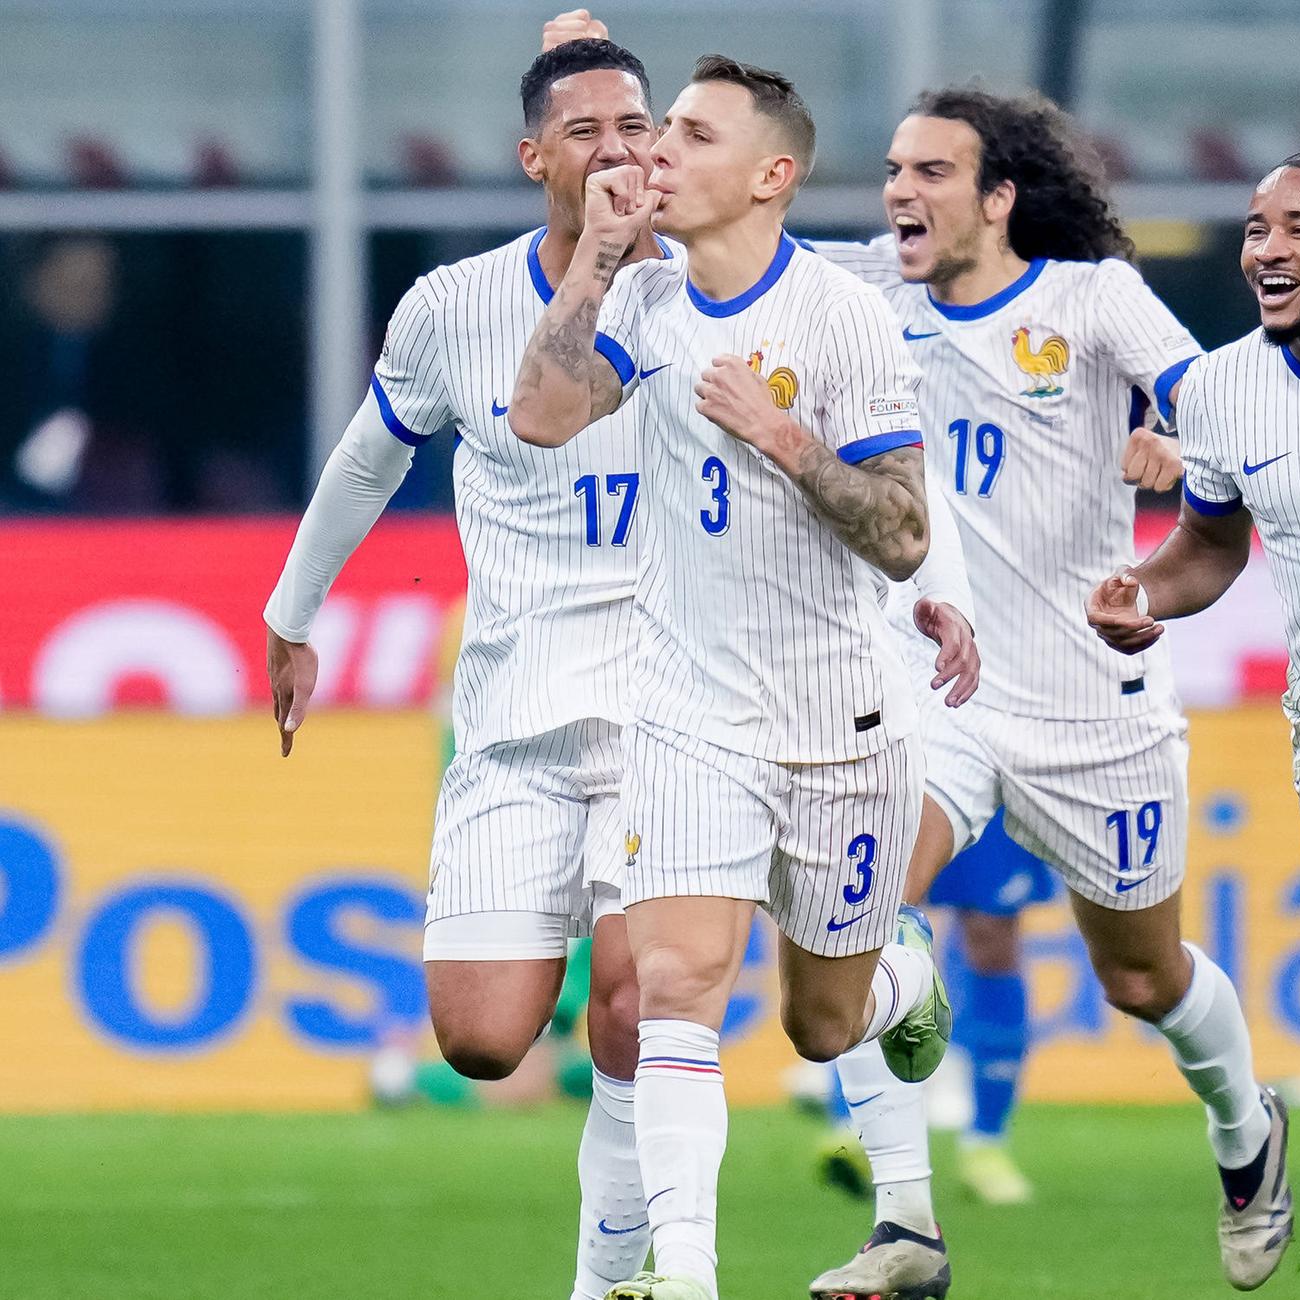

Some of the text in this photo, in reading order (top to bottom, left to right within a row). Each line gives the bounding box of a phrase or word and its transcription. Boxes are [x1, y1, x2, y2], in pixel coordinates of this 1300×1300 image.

[948, 418, 1006, 498] 19
[574, 473, 640, 547] 17
[700, 456, 731, 537] 3
[843, 833, 878, 906] 3
[1106, 801, 1162, 872] 19
